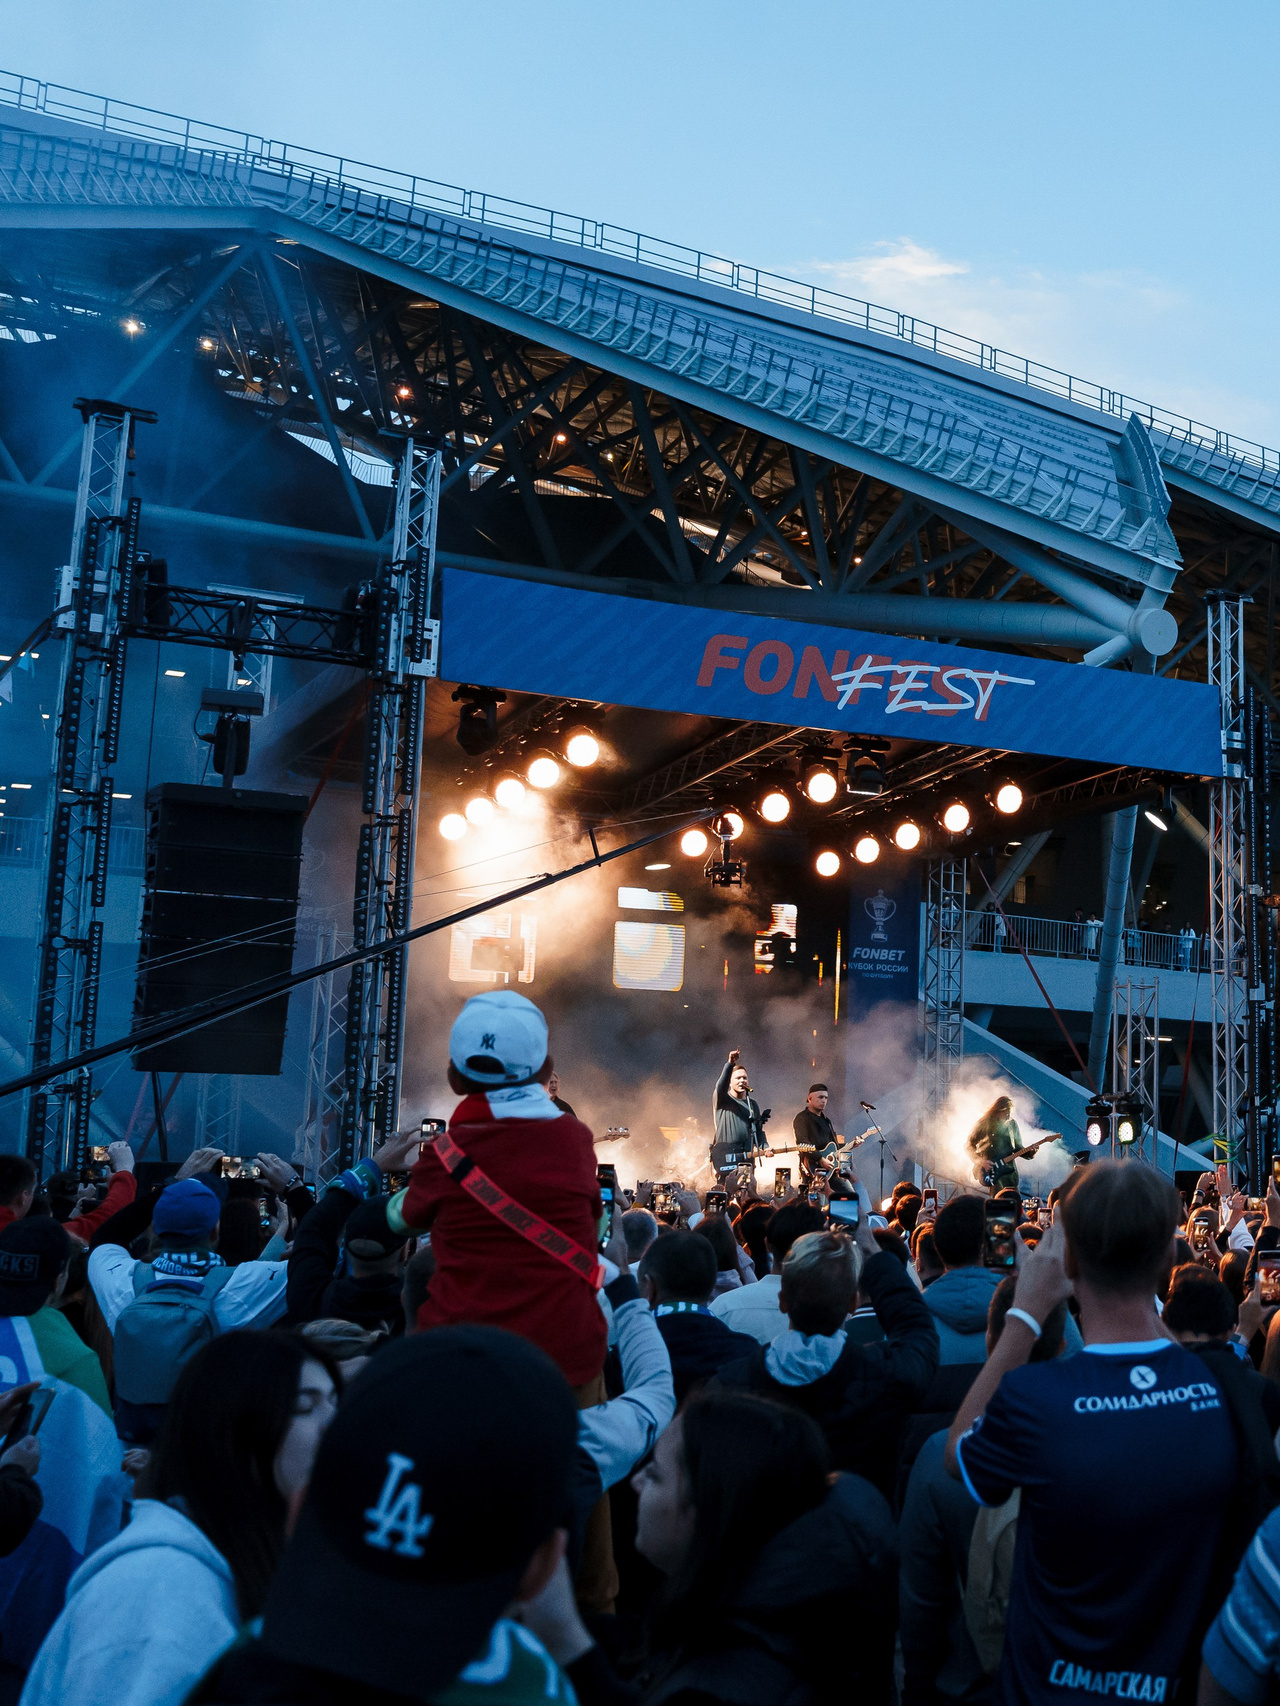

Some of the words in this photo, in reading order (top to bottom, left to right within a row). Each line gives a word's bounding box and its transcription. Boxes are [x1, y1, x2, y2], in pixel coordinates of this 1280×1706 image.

[848, 962, 874, 970] КУБОК
[876, 963, 909, 973] РОССИИ
[853, 947, 905, 961] FONBET
[1074, 1383, 1217, 1413] СОЛИДАРНОСТЬ
[364, 1451, 434, 1558] LA
[1048, 1659, 1168, 1703] САМАРСКАЯ
